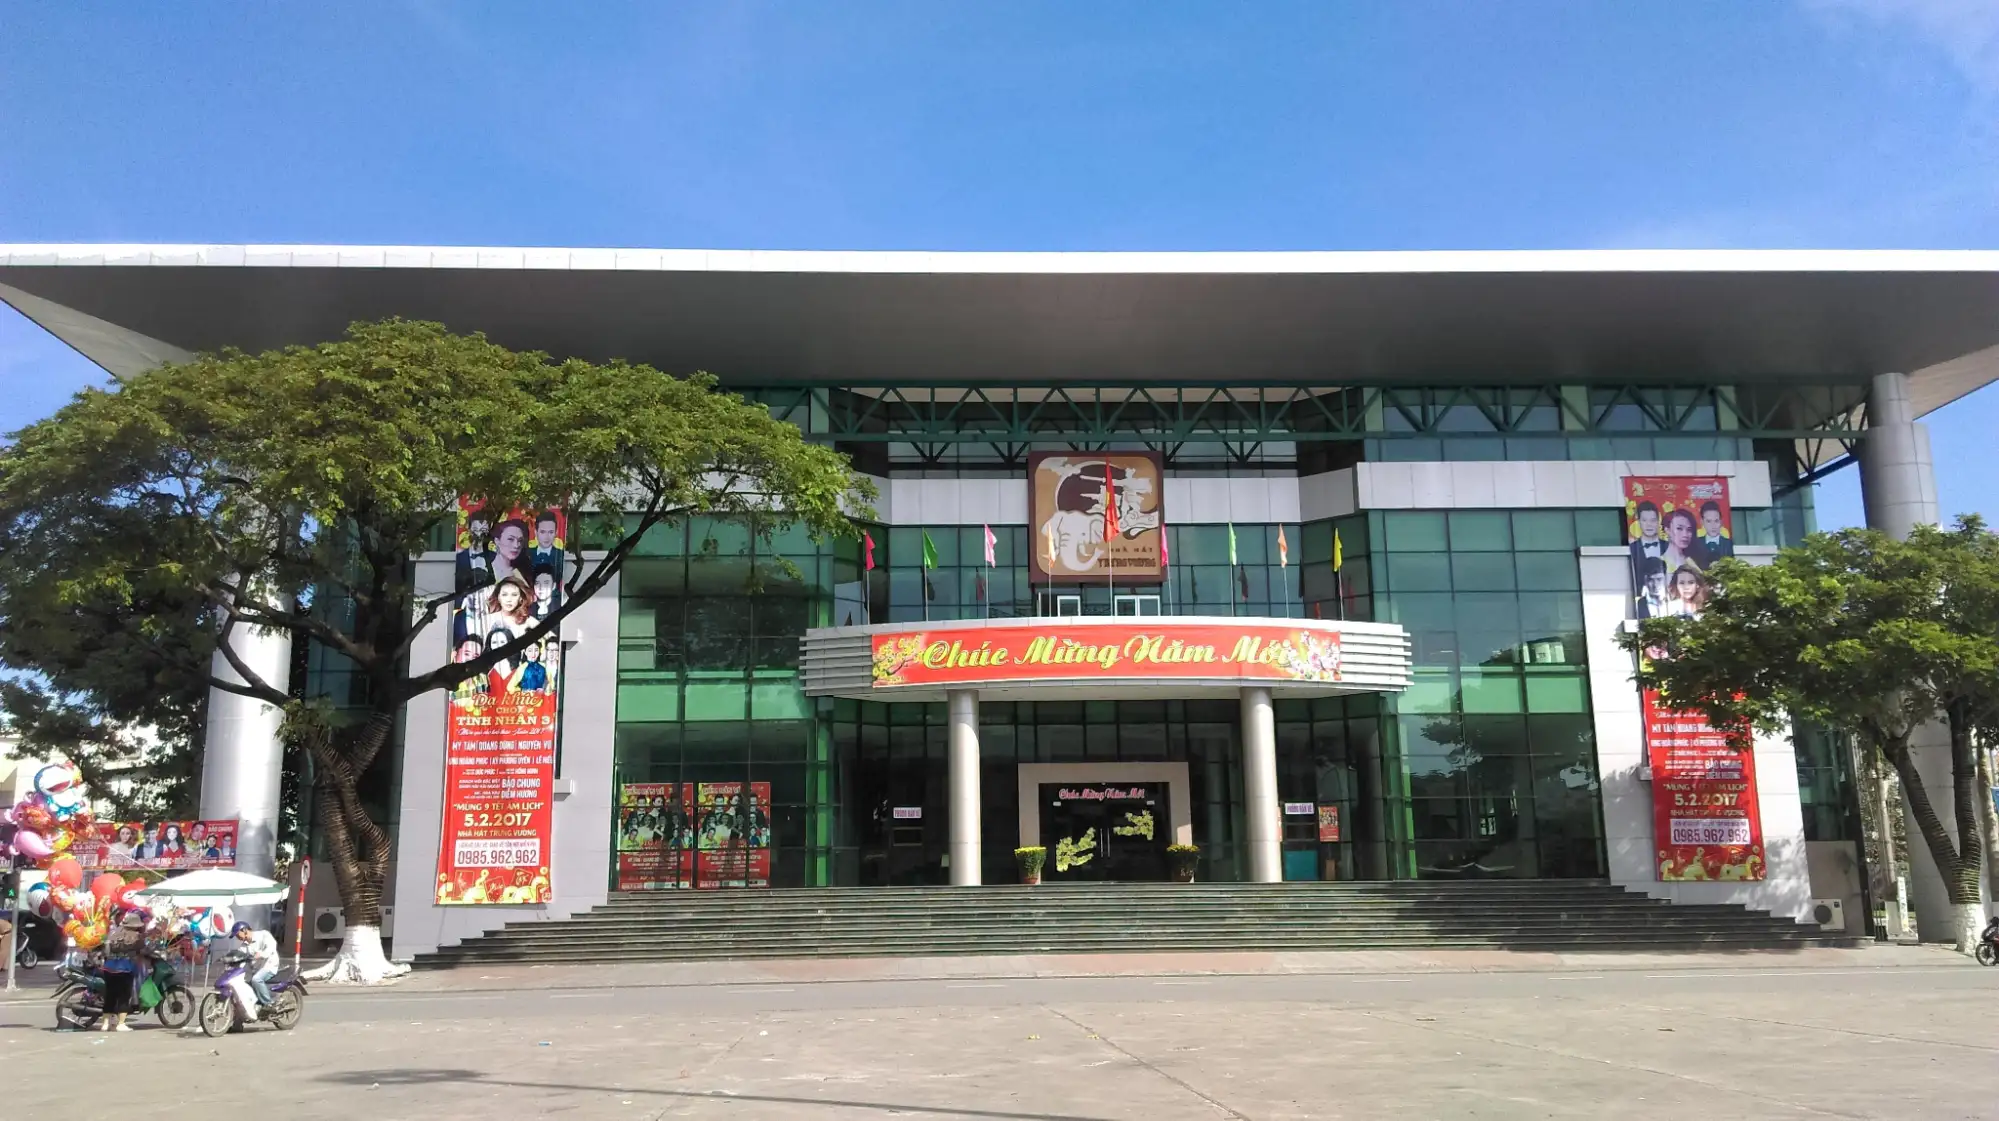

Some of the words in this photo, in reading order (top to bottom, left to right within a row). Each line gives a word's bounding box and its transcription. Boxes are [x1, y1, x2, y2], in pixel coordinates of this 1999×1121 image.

[923, 639, 1009, 669] Chúc
[1014, 635, 1122, 669] Mừng
[1124, 634, 1218, 663] Năm
[1221, 635, 1291, 667] Mới
[472, 692, 496, 708] Dạ
[501, 691, 541, 706] khúc
[456, 712, 492, 726] TÌNH
[495, 712, 537, 726] NHÂN
[541, 715, 551, 725] 3
[502, 776, 515, 788] BẢO
[516, 778, 541, 789] CHUNG
[484, 802, 490, 810] 9
[1675, 793, 1739, 806] 5.2.2017
[463, 812, 532, 827] 5.2.2017
[1673, 828, 1748, 843] 0985.962.962
[458, 849, 537, 864] 0985.962.962
